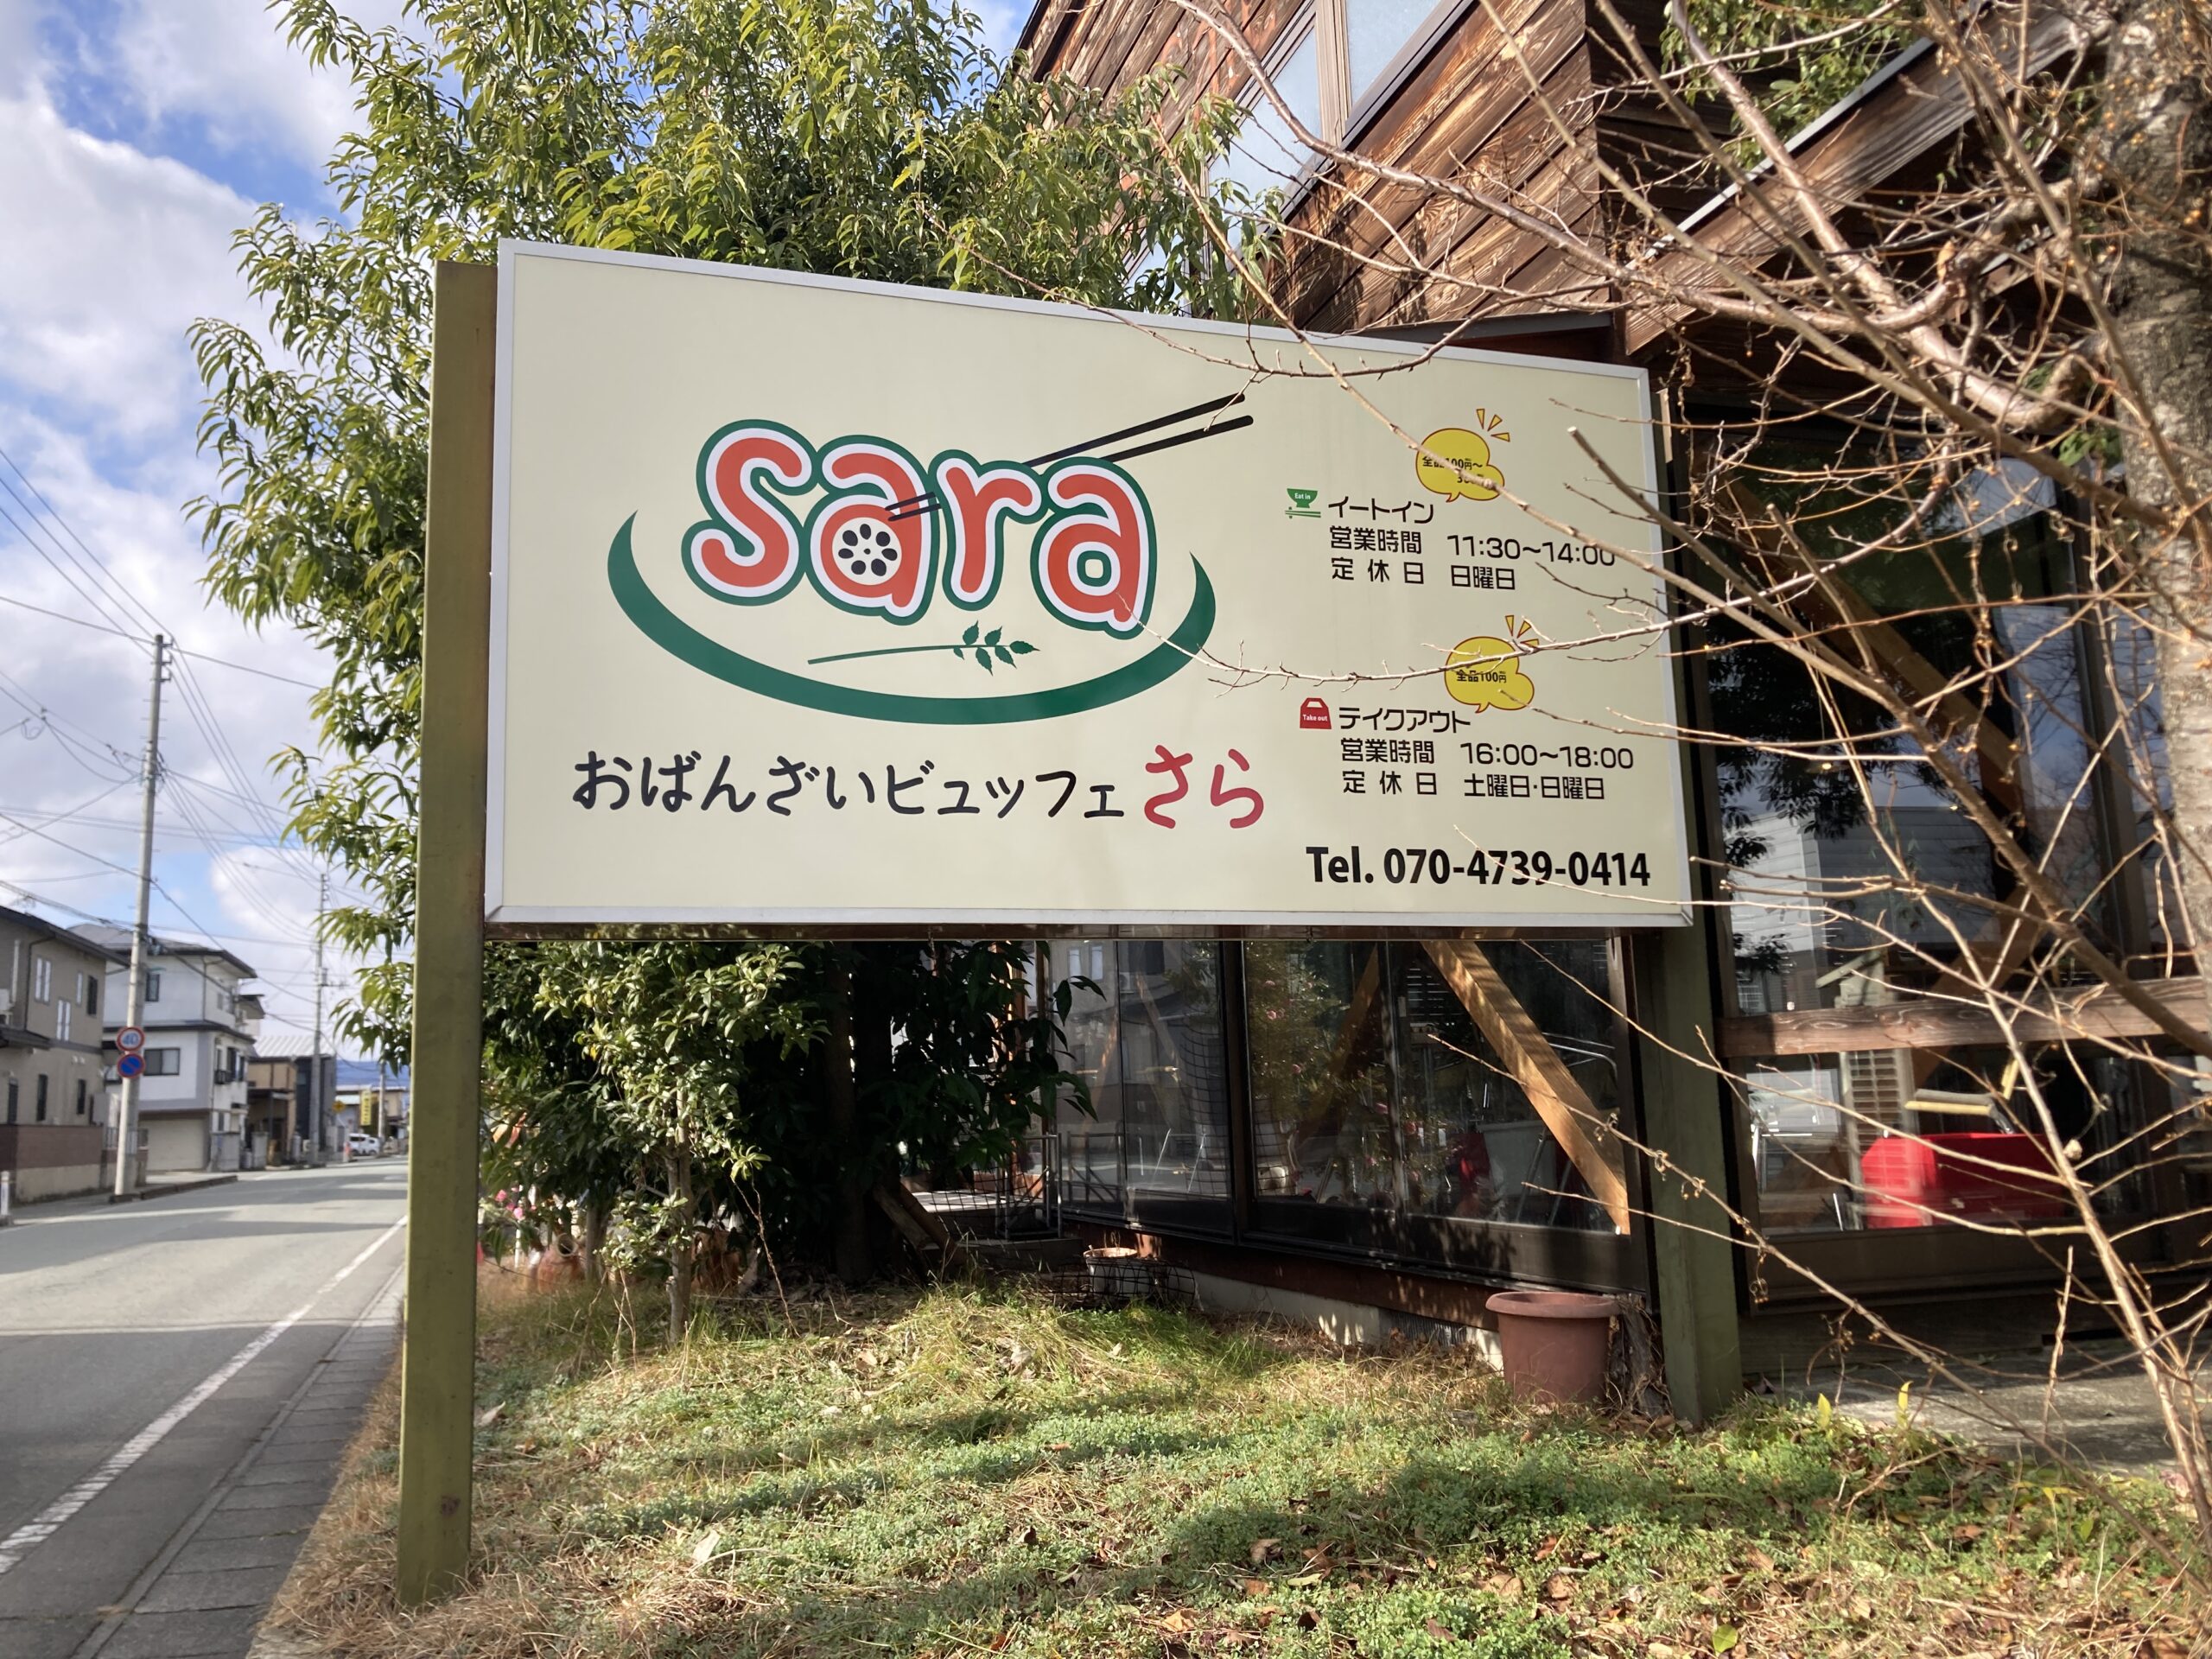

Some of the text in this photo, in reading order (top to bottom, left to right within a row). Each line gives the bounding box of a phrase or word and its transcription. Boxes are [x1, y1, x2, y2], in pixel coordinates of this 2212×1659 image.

[1328, 496, 1434, 524] イートイン
[689, 423, 1151, 633] sara
[1329, 525, 1422, 555] 営業時間
[1451, 564, 1516, 590] 日曜日
[1338, 706, 1471, 734] テイクアウト
[1341, 737, 1435, 765] 営業時間
[572, 744, 1264, 830] おばんざいビュッフェ さら
[1306, 845, 1651, 887] Tel. 070-4739-0414
